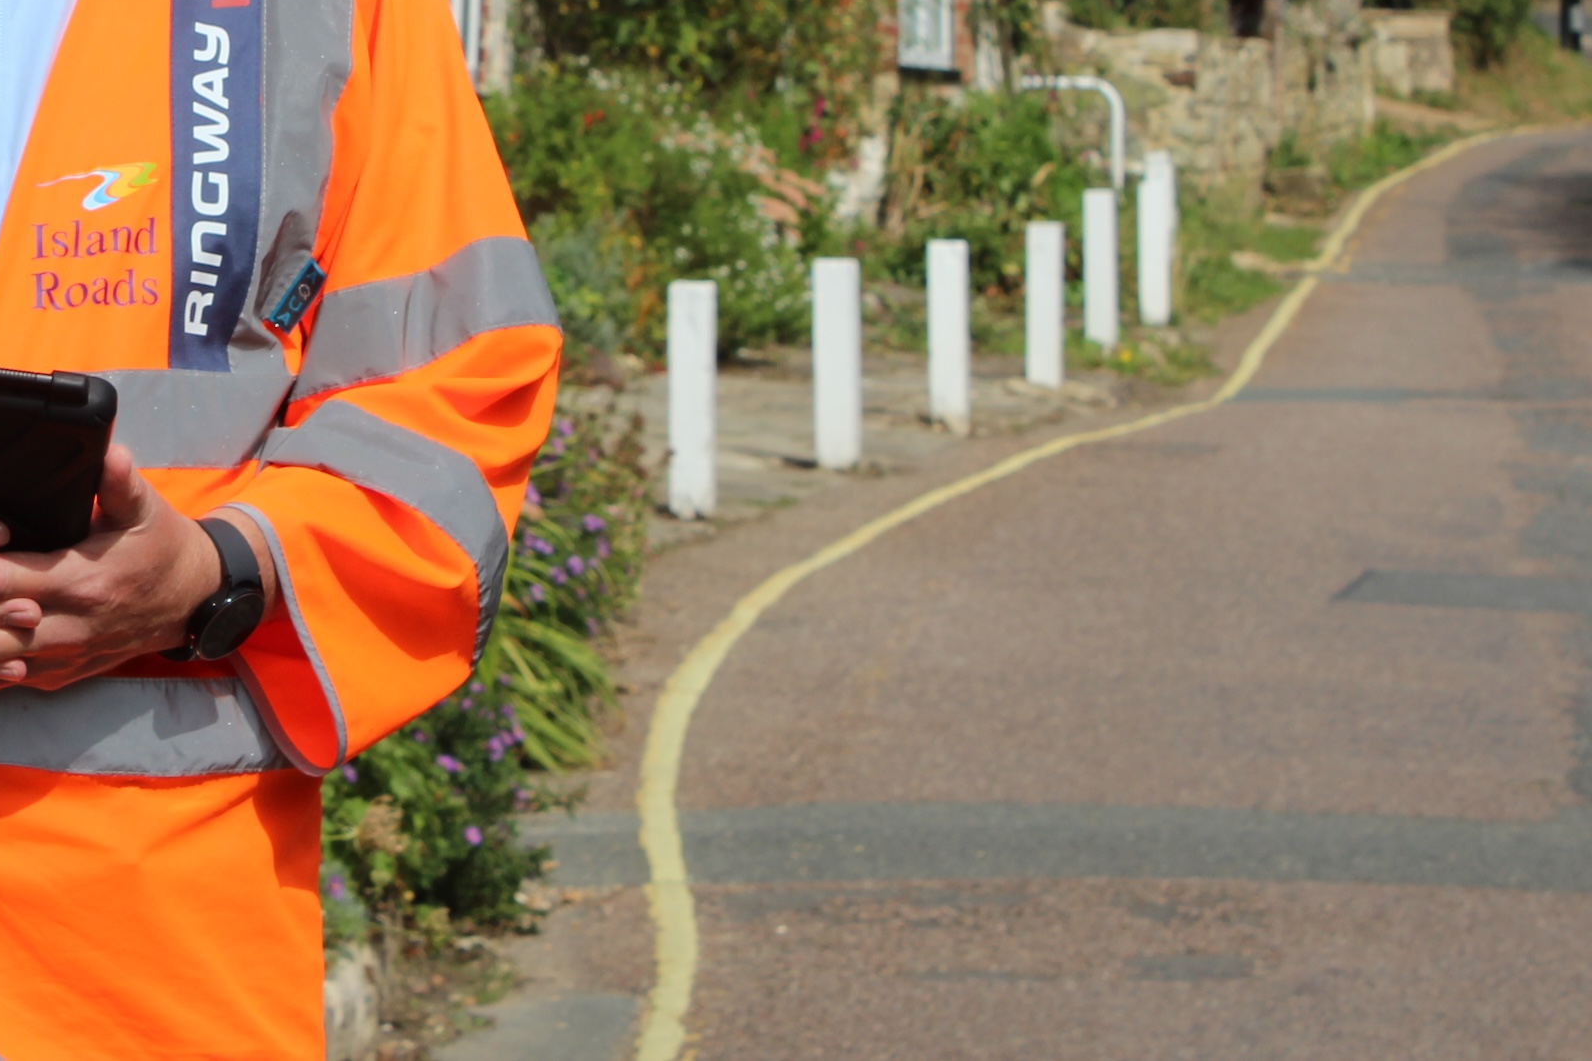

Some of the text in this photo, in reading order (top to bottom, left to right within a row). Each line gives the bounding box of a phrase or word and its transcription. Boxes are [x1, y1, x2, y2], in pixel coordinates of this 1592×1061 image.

[184, 22, 231, 336] RINGWAY
[32, 217, 159, 259] Island
[32, 271, 159, 310] Roads
